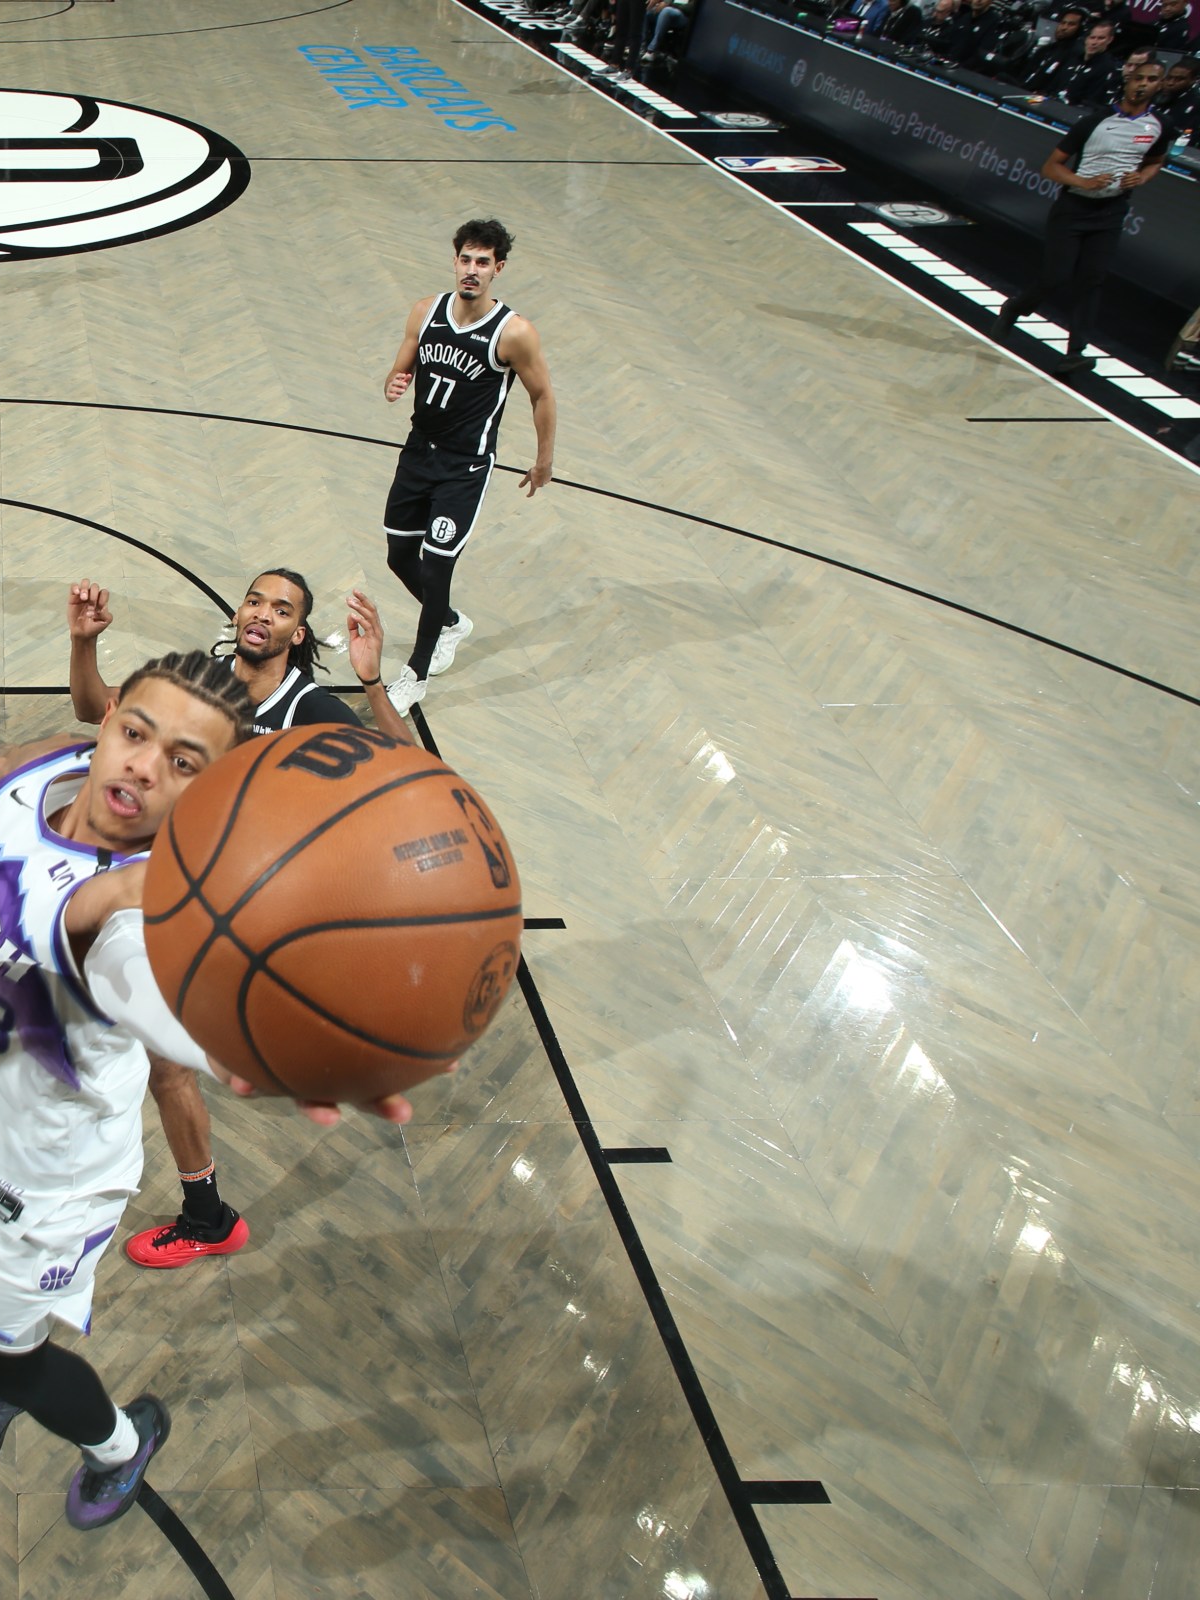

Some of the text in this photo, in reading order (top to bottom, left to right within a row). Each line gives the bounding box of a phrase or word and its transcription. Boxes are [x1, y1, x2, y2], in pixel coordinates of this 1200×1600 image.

[297, 44, 409, 111] CENTER
[361, 46, 518, 133] BARCLAYS
[812, 72, 856, 106] Official
[853, 90, 906, 135] Banking
[903, 112, 961, 153] Partner
[960, 141, 985, 162] of
[979, 146, 1009, 176] the
[1007, 157, 1064, 201] Brook
[419, 343, 486, 381] BROOKLYN
[426, 372, 457, 409] 77
